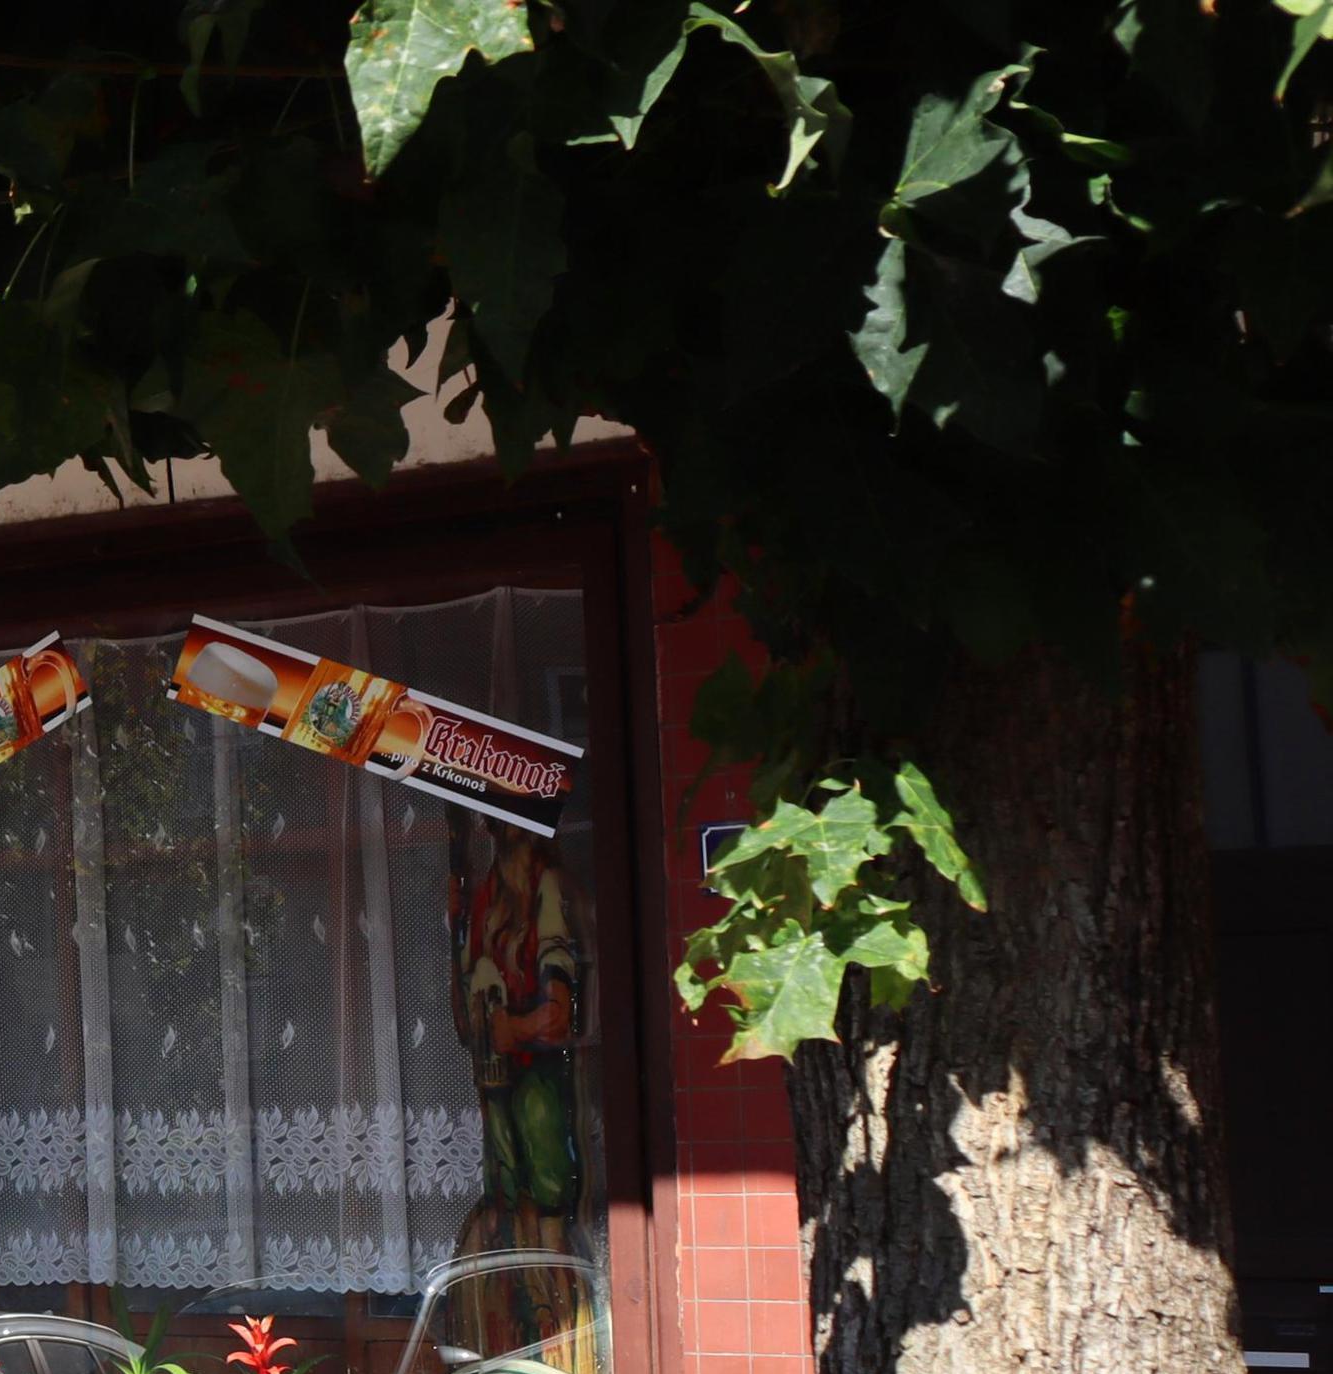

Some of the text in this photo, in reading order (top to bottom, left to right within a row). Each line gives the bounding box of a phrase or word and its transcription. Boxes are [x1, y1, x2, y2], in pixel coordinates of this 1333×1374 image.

[421, 761, 430, 772] z
[433, 765, 487, 793] Krkonoš
[424, 715, 566, 798] Krakonoš
